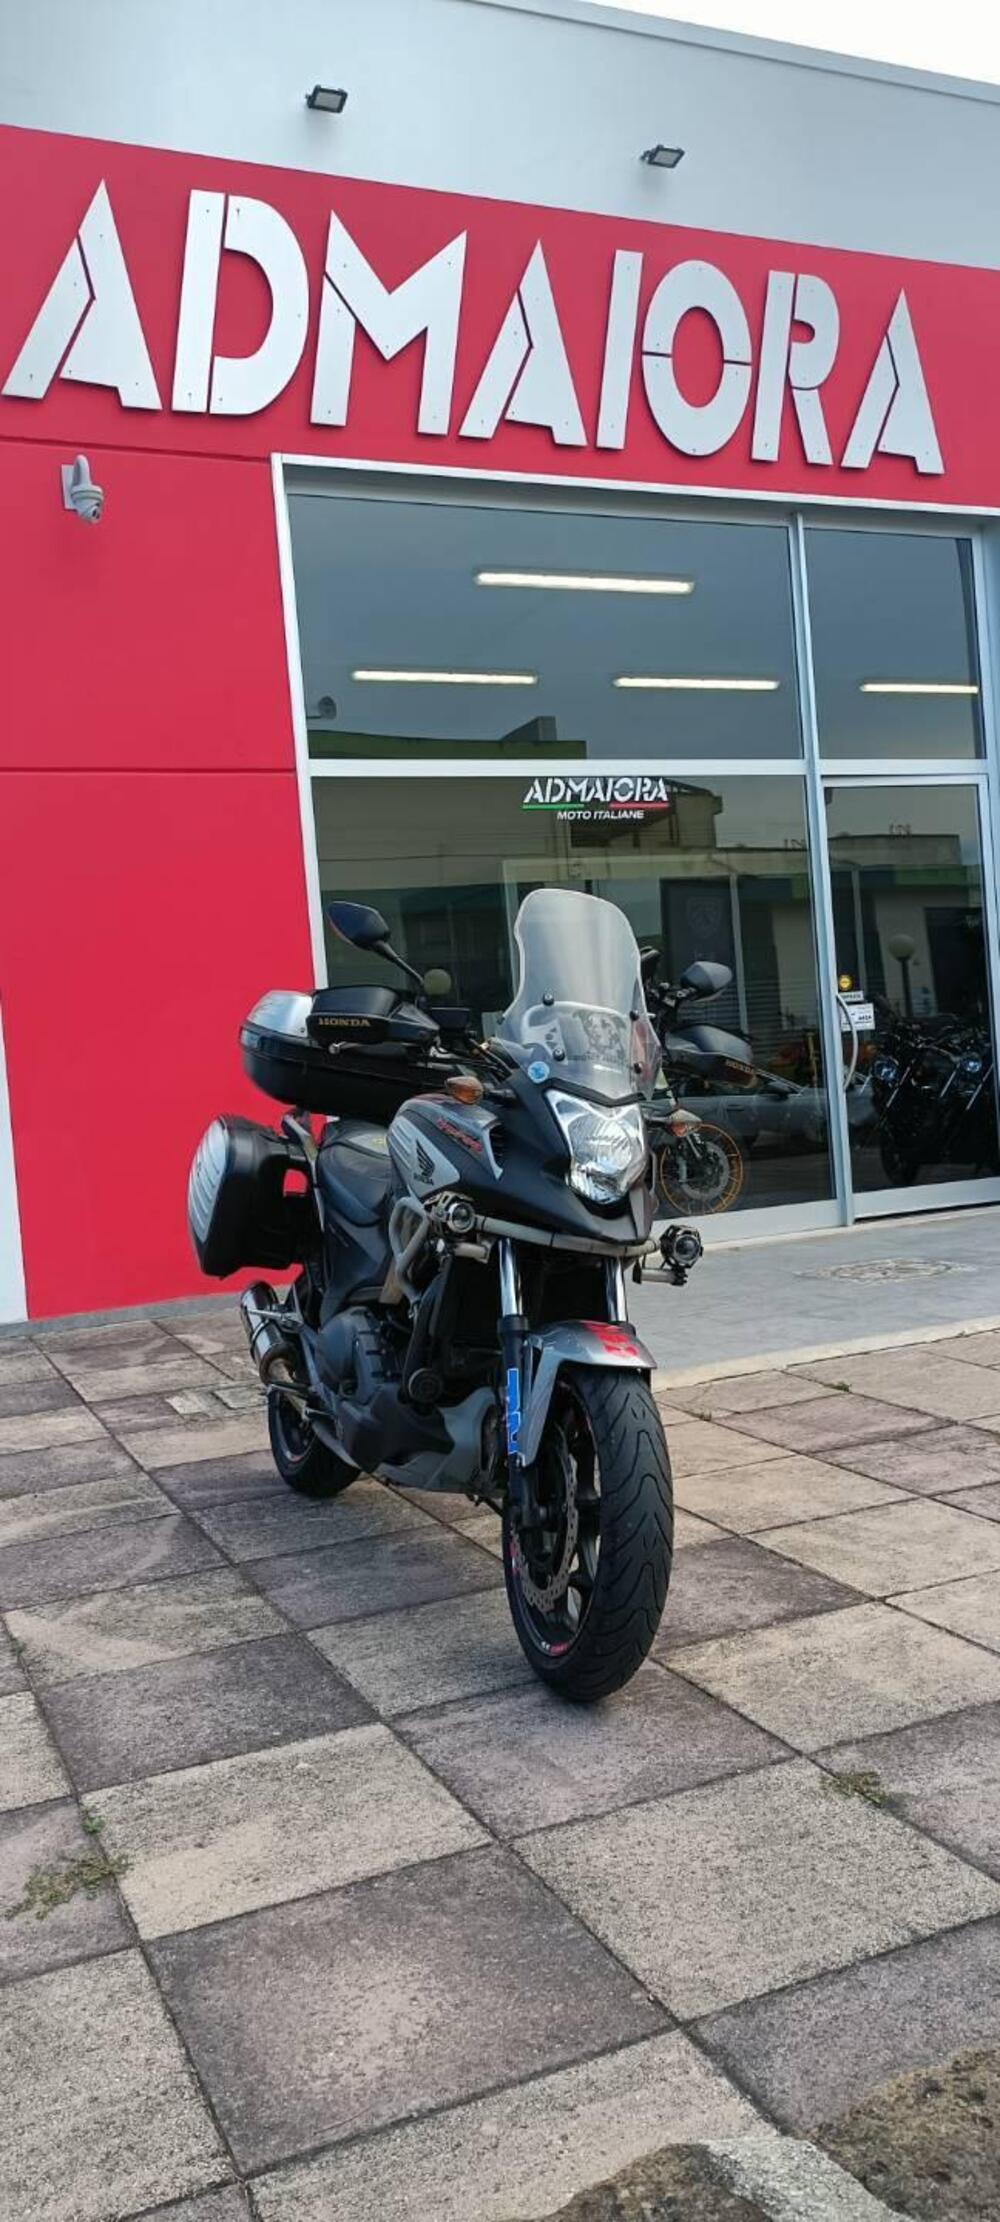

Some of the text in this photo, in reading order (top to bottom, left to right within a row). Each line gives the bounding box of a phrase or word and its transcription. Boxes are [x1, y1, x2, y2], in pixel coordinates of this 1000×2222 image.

[2, 179, 944, 475] ADMAIORA
[523, 777, 669, 803] ADMAIORA
[556, 810, 645, 820] MOTO ITALIANE
[318, 1017, 371, 1028] HONDA
